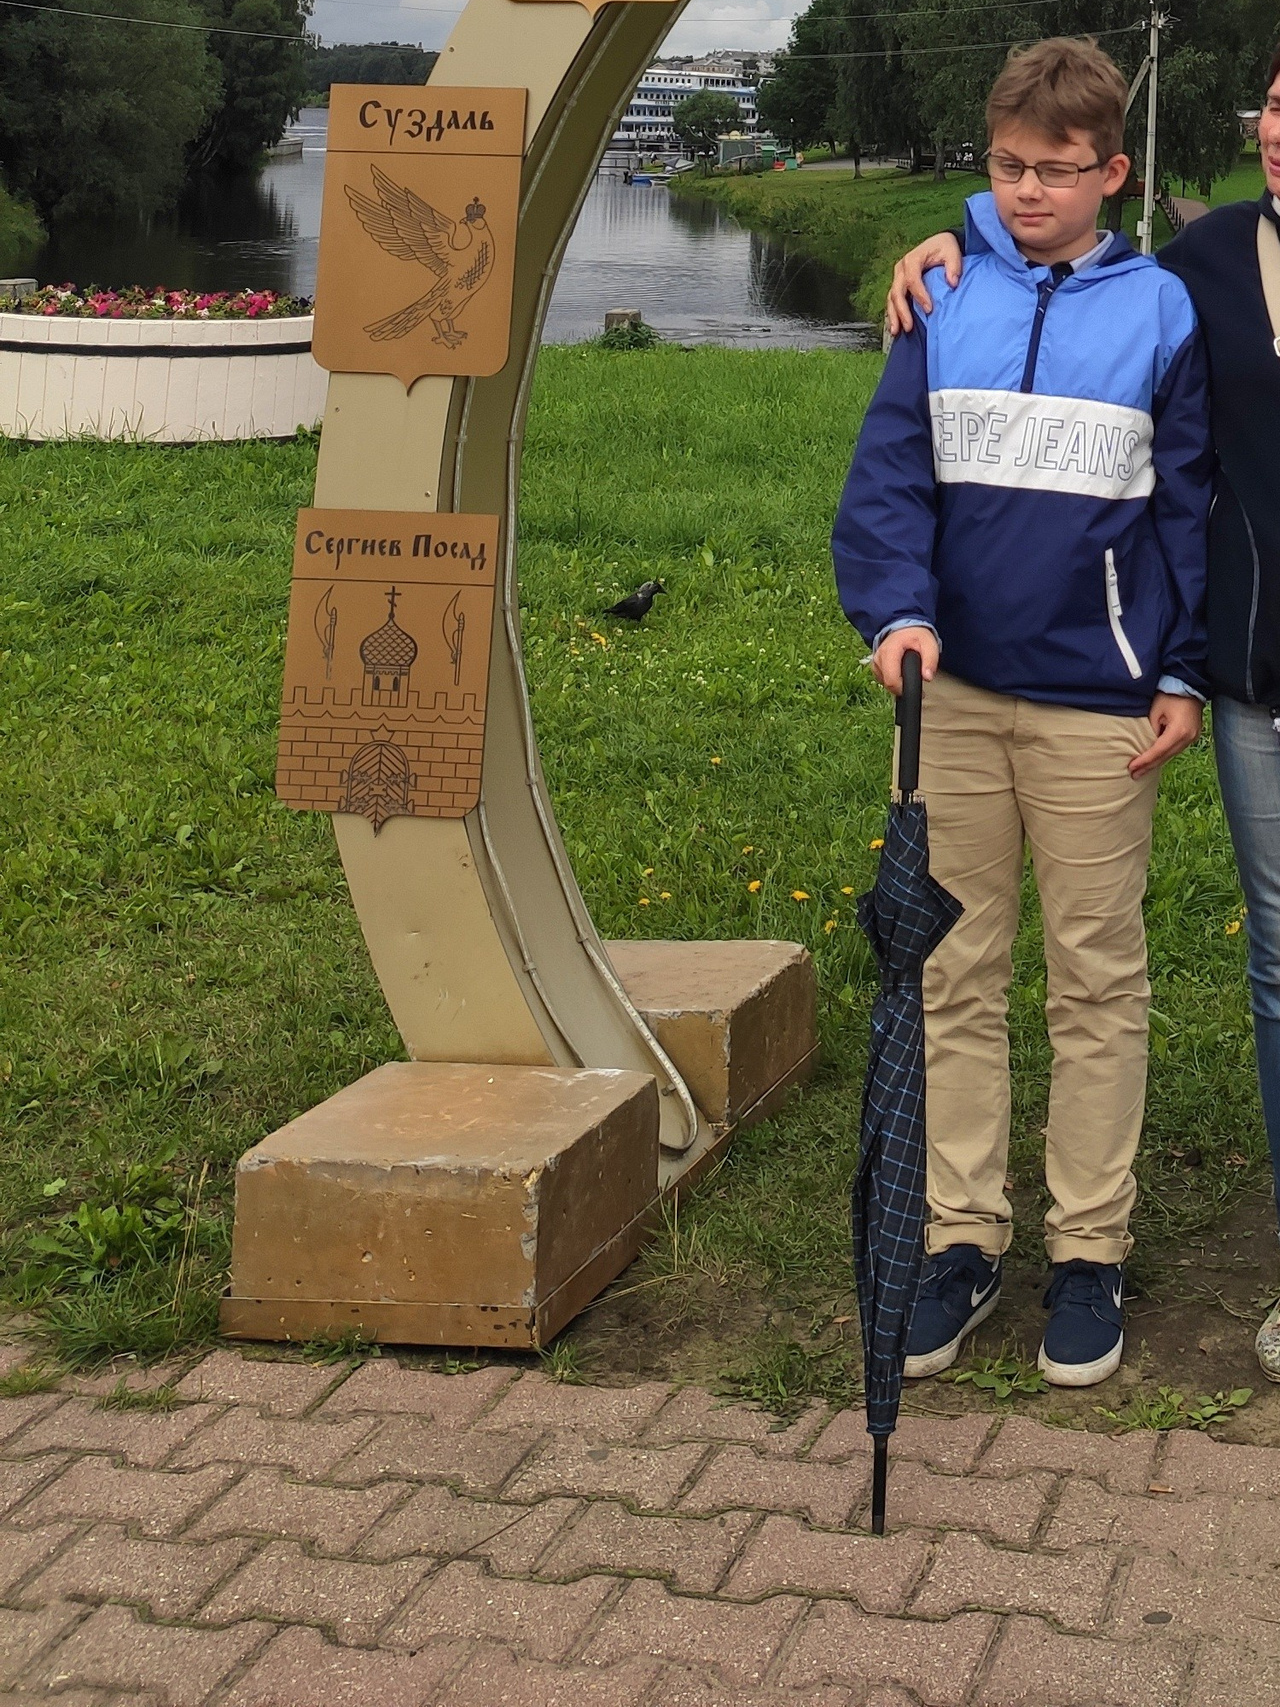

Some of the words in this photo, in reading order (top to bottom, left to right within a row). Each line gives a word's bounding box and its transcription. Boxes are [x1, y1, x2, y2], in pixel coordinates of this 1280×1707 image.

[359, 100, 494, 145] Суздаль
[931, 411, 1008, 465] EPE
[1014, 416, 1140, 482] JEANS
[305, 530, 401, 571] Сергиев
[412, 534, 487, 571] Посад
